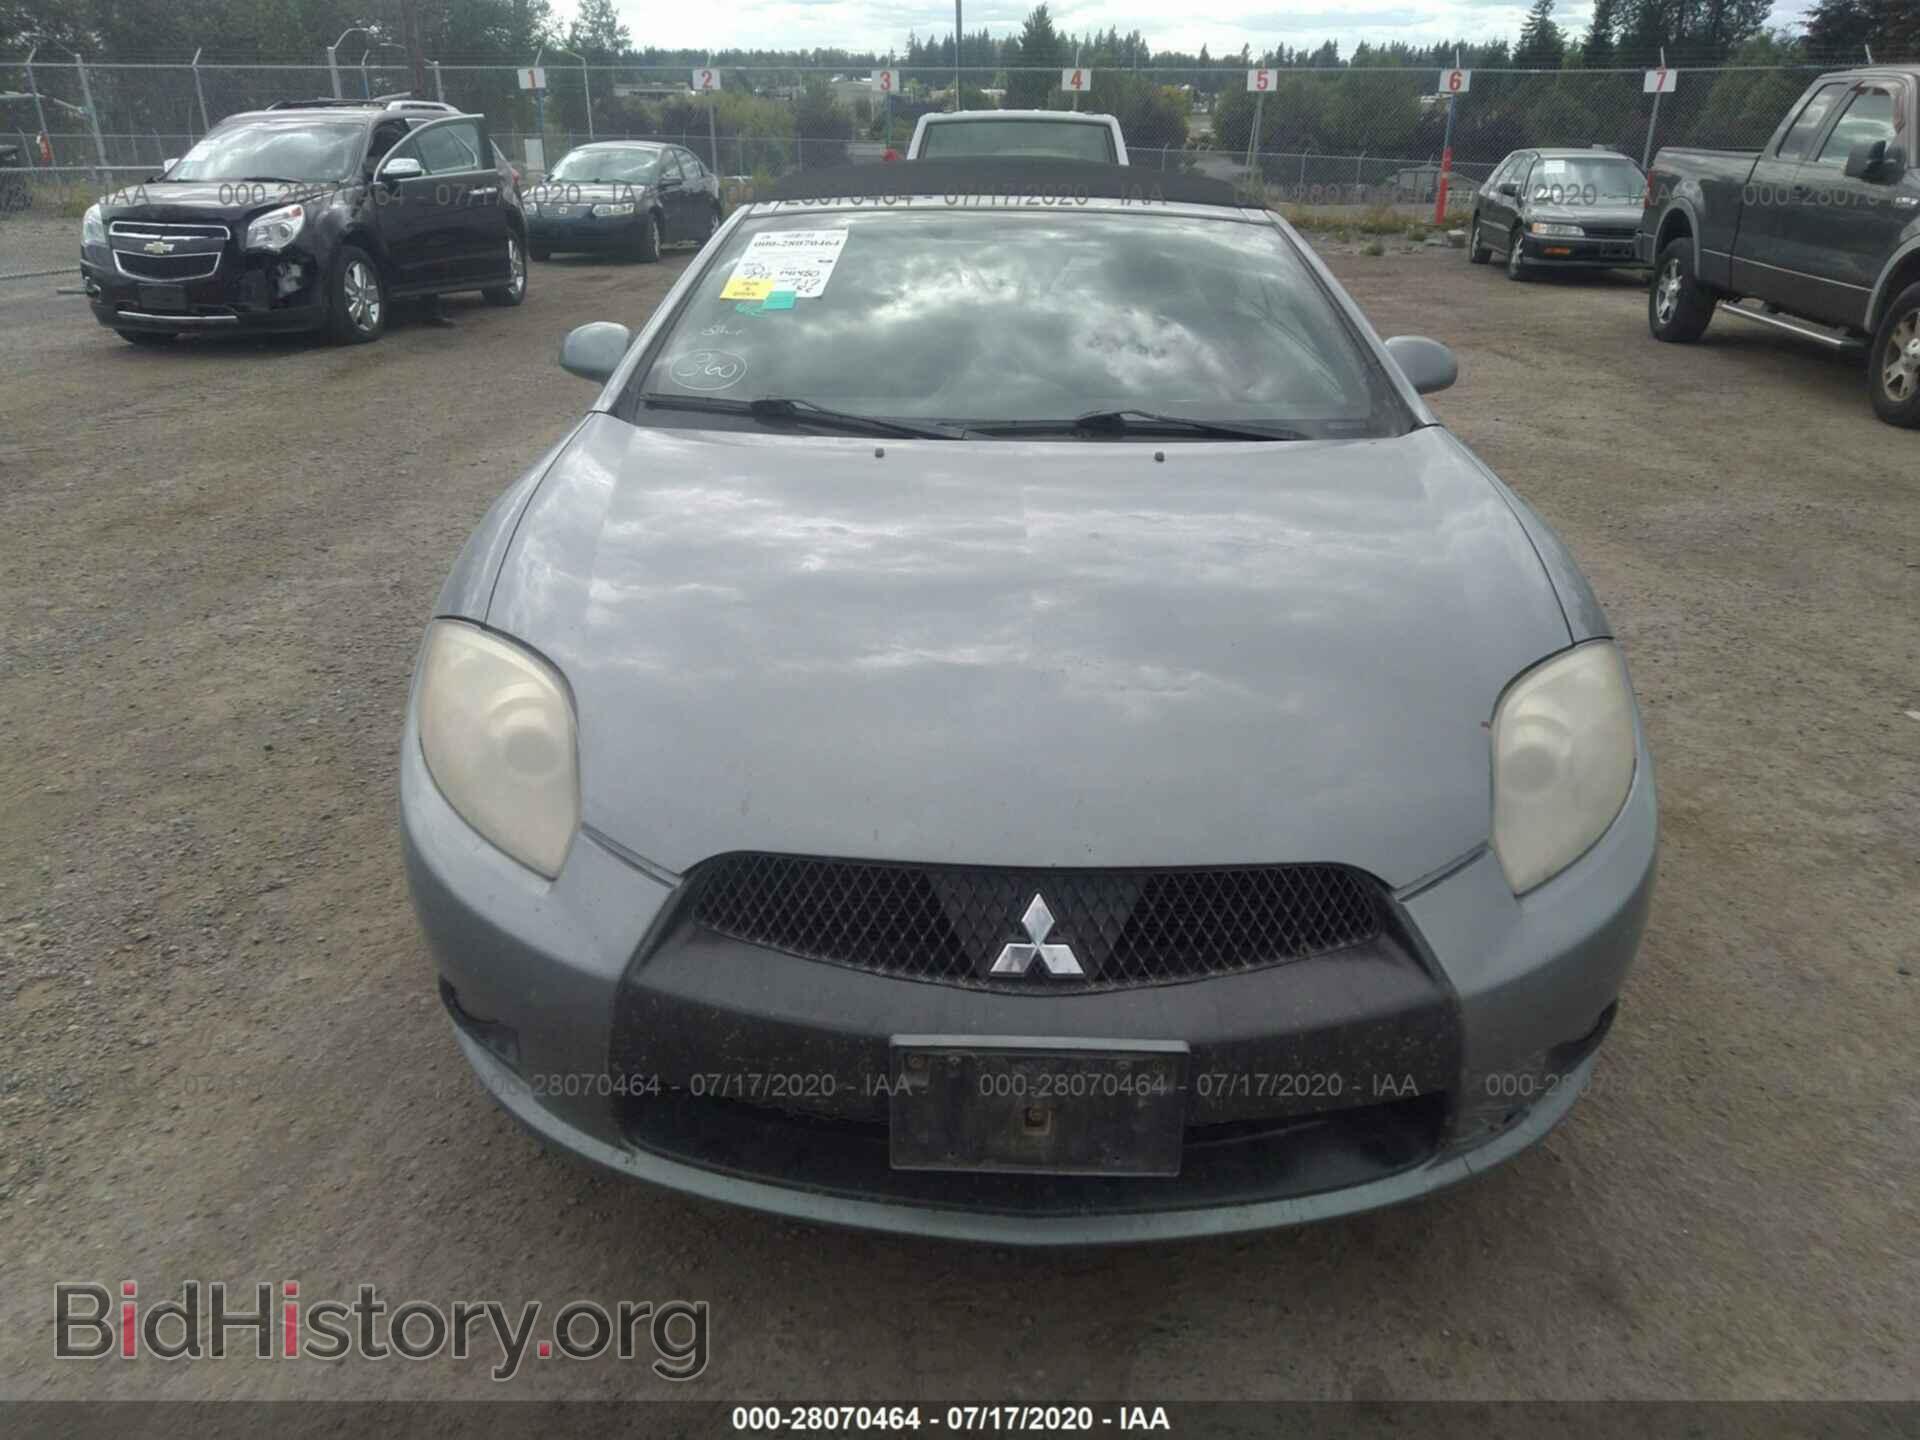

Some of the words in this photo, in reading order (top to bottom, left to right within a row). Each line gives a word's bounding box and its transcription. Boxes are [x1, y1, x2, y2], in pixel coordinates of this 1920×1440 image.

[528, 70, 536, 89] 1
[702, 71, 712, 88] 2
[880, 72, 891, 90] 3
[1070, 70, 1083, 89] 4
[1256, 71, 1269, 90] 5
[1449, 71, 1461, 91] 6
[1656, 71, 1668, 91] 7
